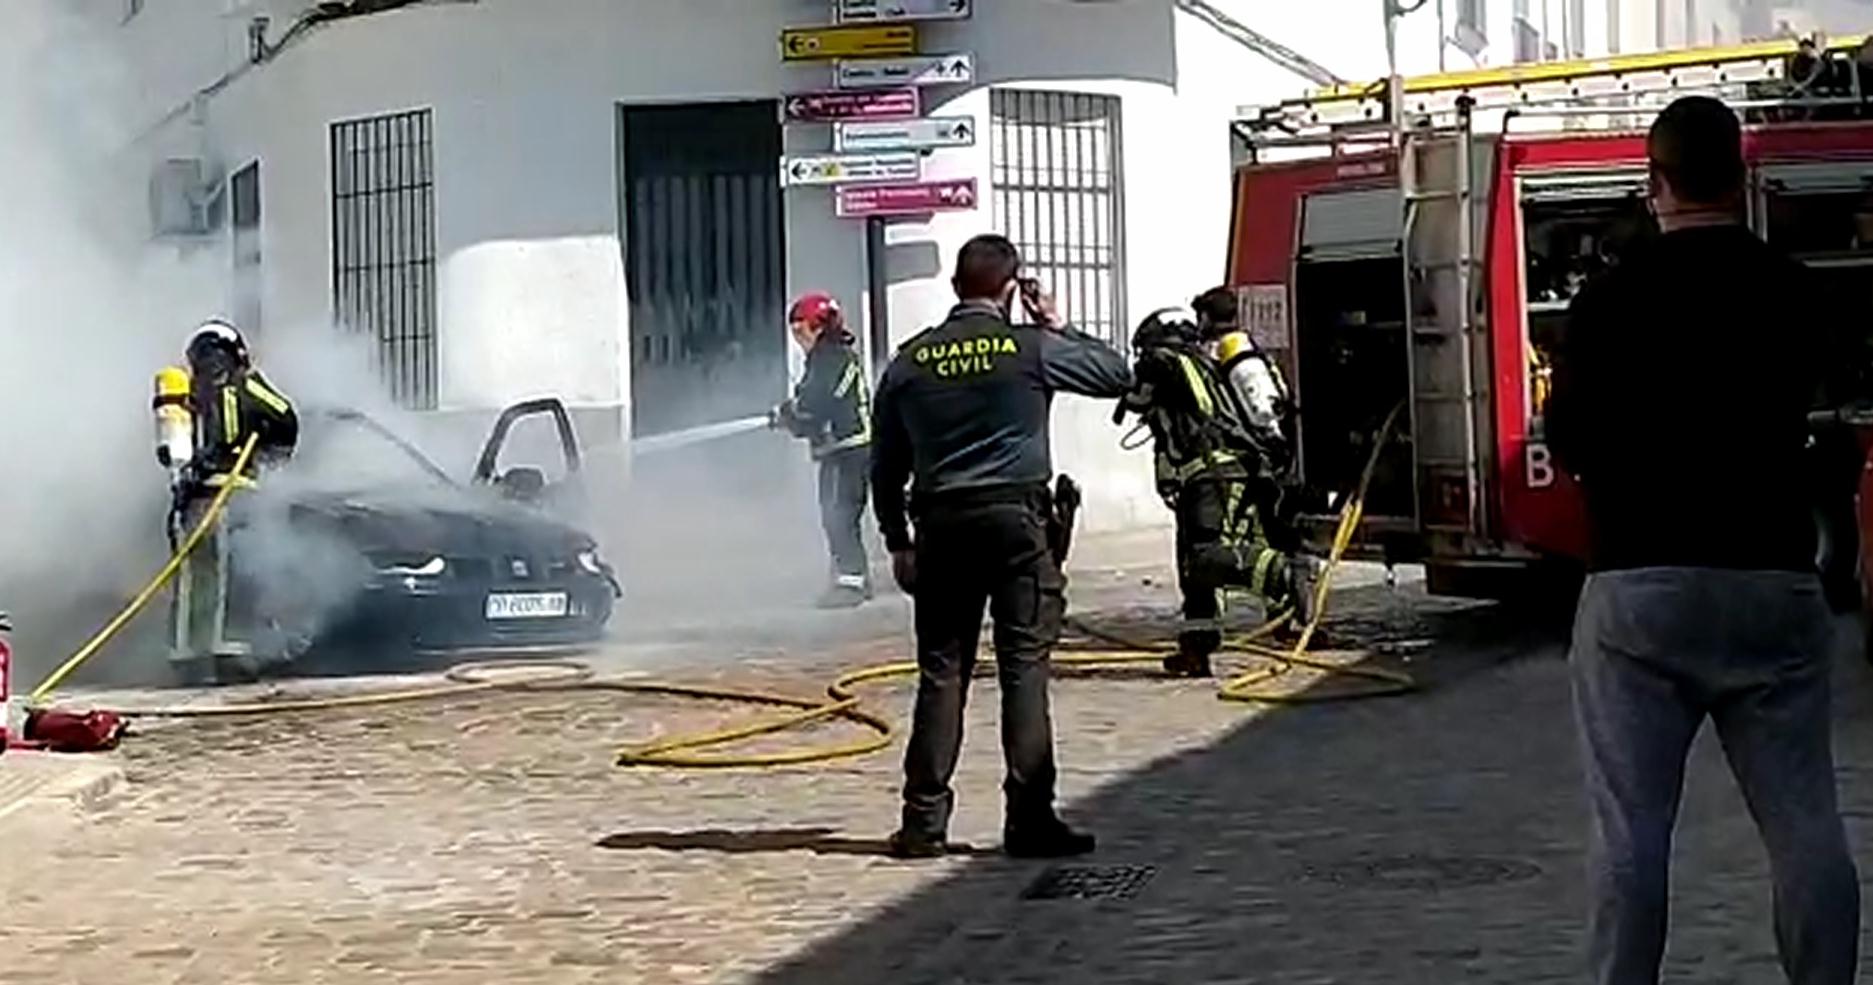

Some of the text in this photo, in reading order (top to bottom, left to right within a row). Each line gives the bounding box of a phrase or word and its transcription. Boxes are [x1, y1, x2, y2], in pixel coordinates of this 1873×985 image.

[916, 338, 1017, 362] GUARDIA
[937, 355, 992, 376] CIVIL
[1526, 444, 1554, 487] B
